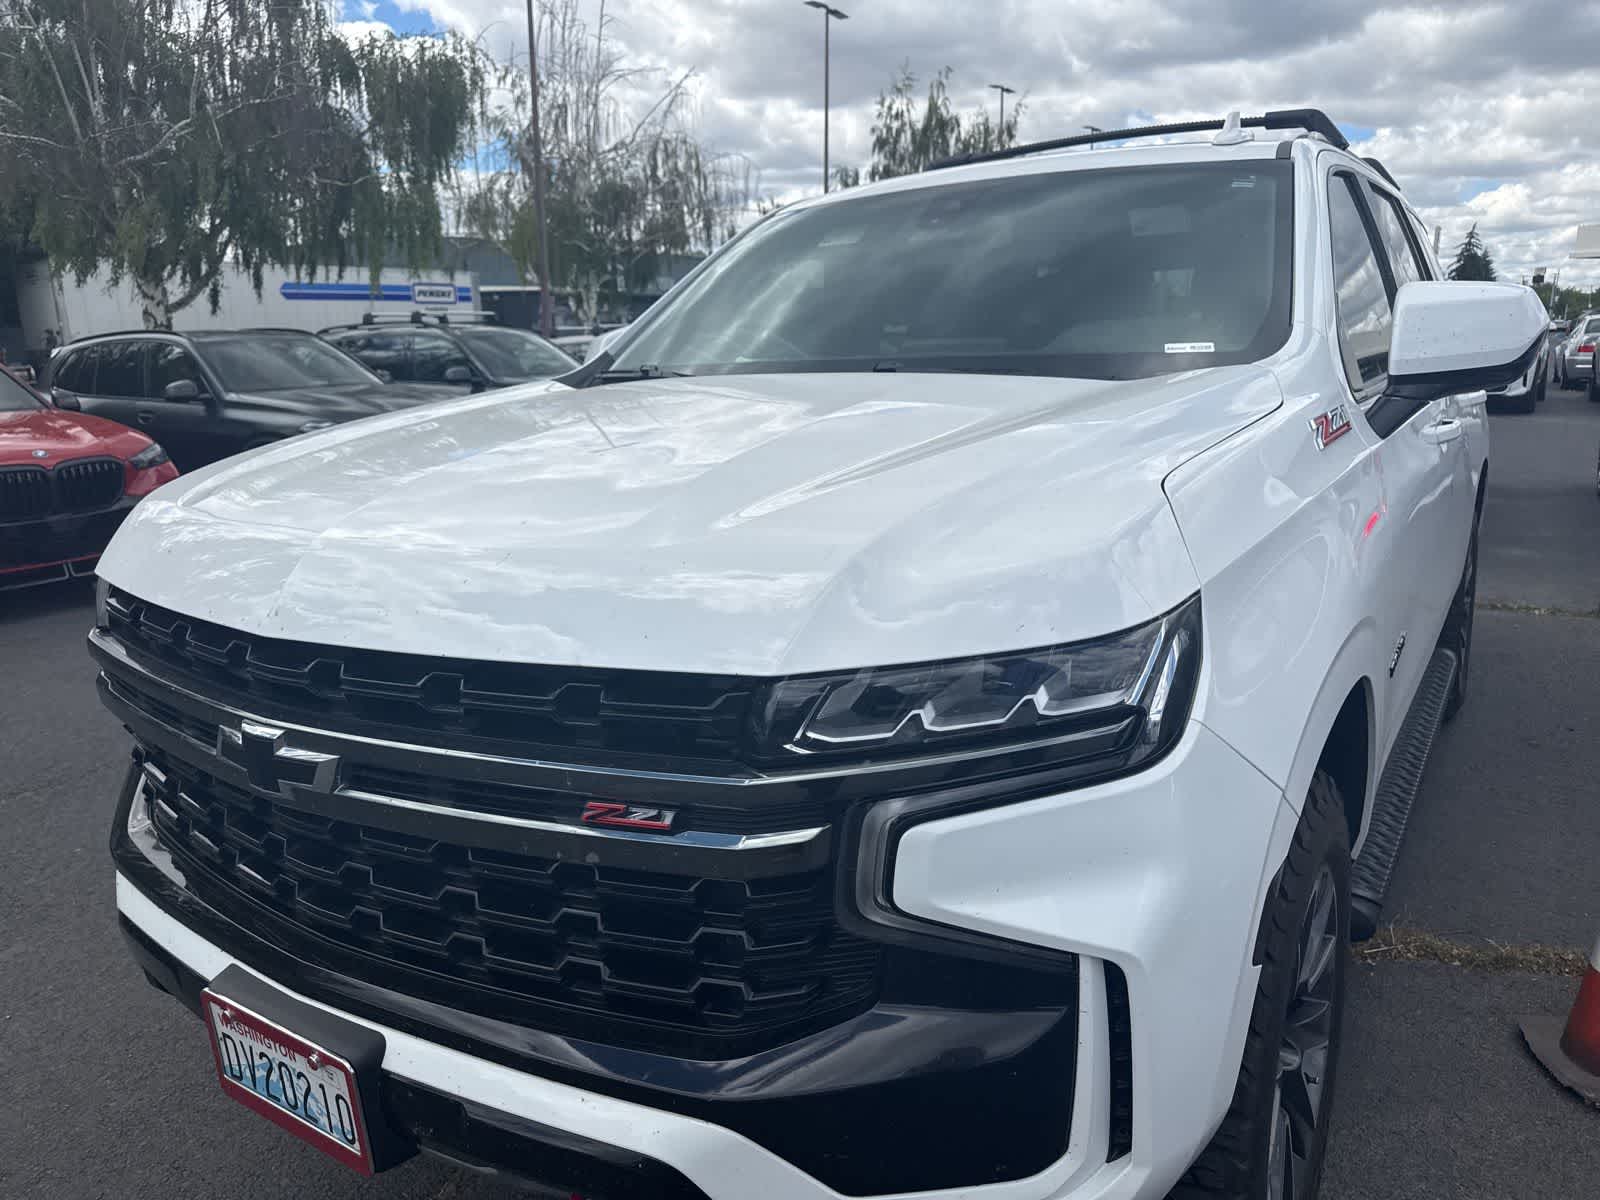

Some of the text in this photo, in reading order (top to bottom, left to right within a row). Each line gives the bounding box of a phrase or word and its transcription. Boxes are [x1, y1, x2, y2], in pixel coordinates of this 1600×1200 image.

[1306, 404, 1352, 451] Z71
[581, 801, 677, 830] Z71
[221, 1031, 357, 1146] DV20210
